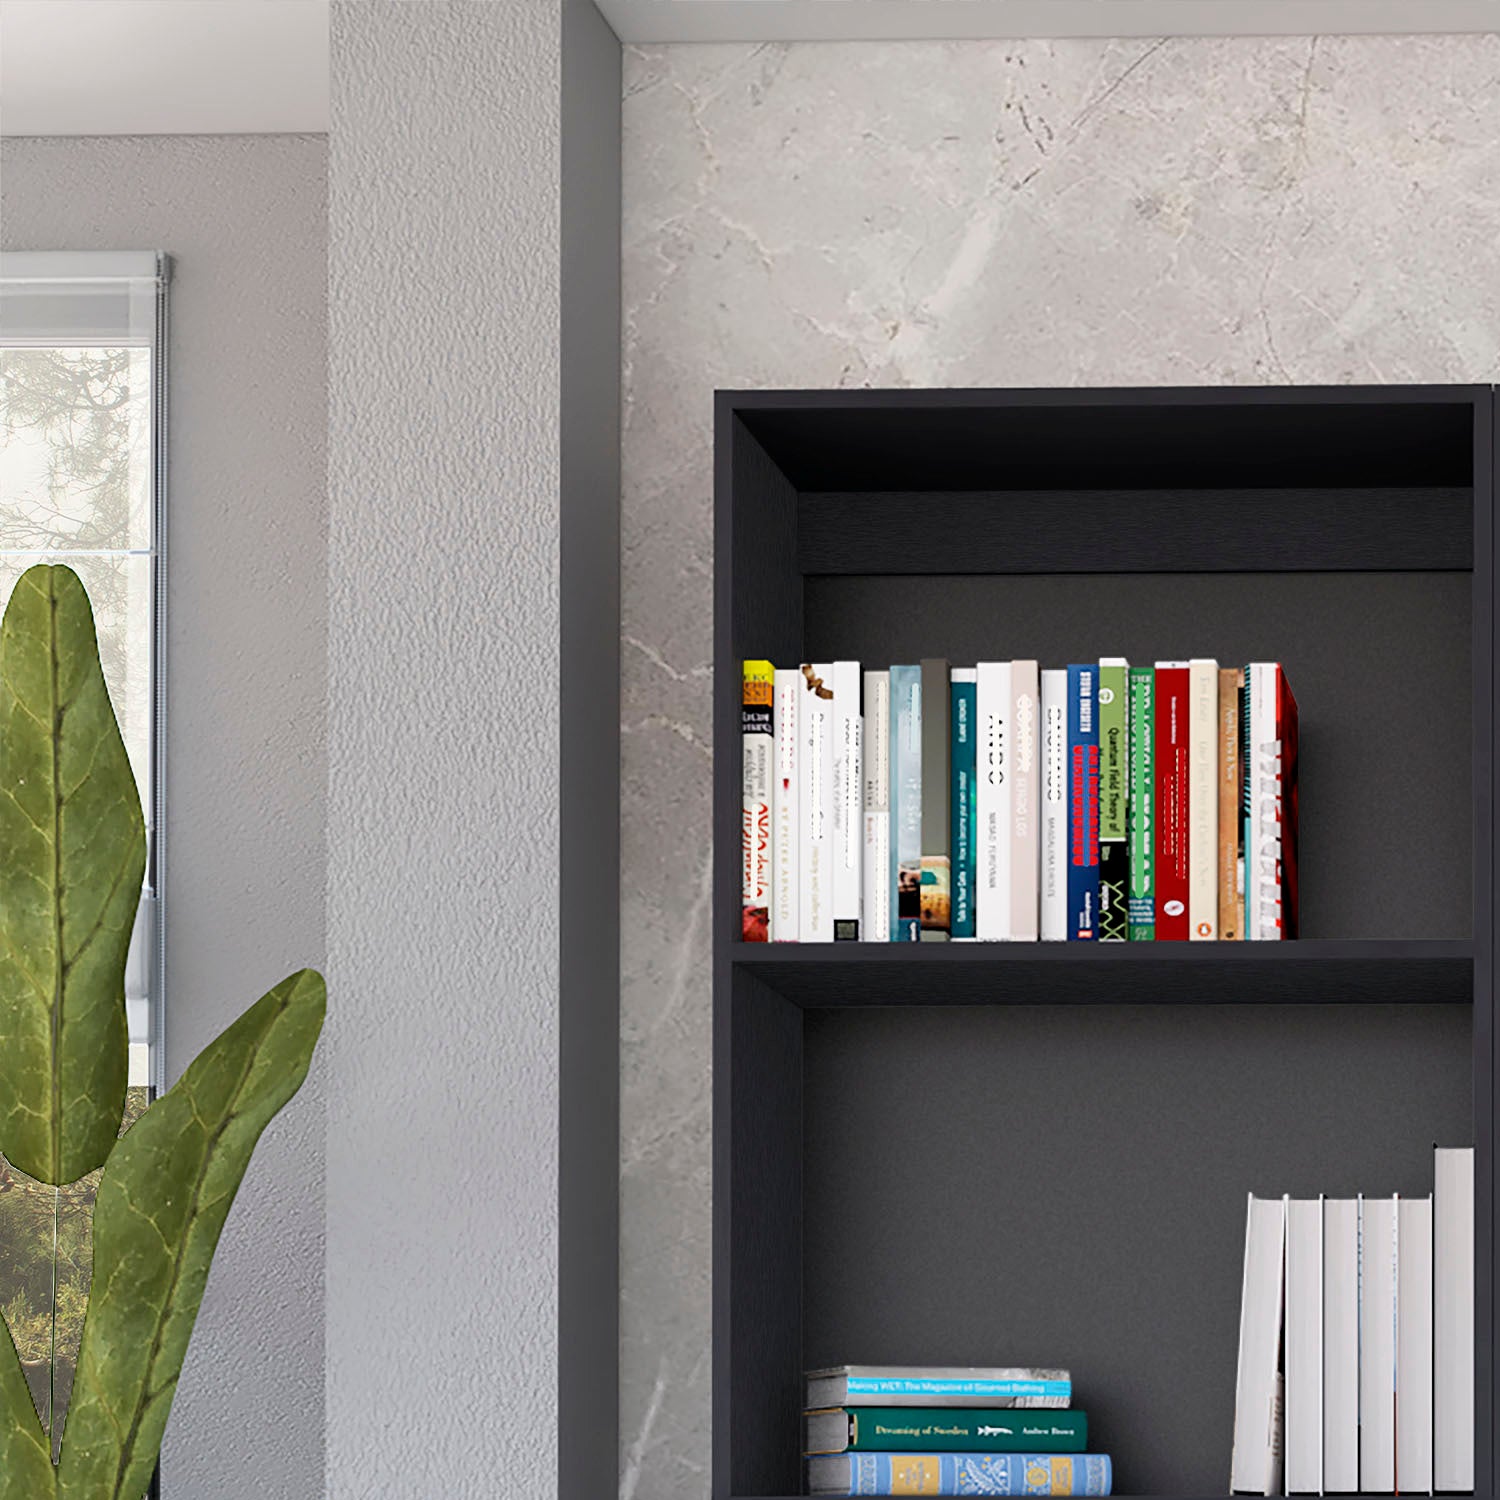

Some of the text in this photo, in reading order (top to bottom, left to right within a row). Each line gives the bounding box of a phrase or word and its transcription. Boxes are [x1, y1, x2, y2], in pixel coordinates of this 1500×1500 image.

[1107, 727, 1120, 833] Quantum Field Theory of
[781, 870, 789, 921] ARNOLD
[905, 1381, 922, 1392] The
[924, 1381, 964, 1394] Magazine
[965, 1382, 974, 1393] of
[921, 1424, 932, 1435] of
